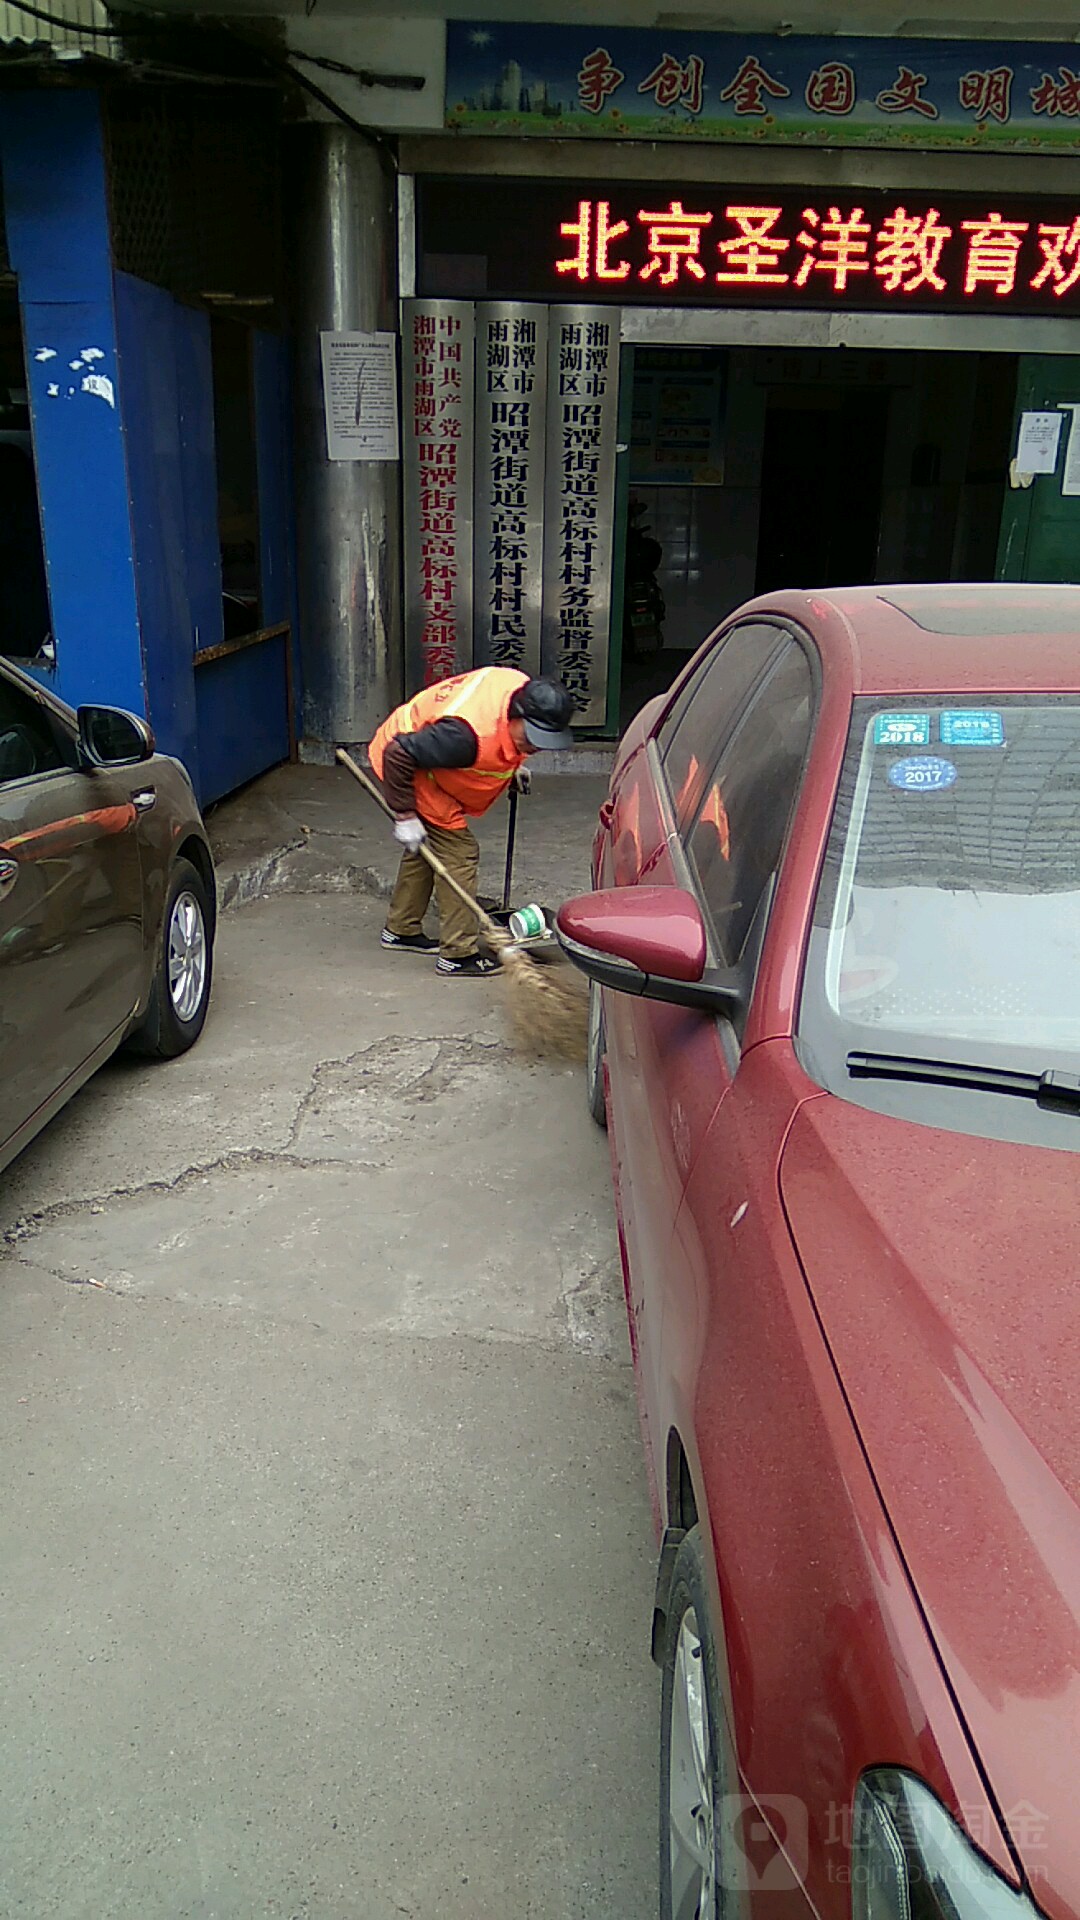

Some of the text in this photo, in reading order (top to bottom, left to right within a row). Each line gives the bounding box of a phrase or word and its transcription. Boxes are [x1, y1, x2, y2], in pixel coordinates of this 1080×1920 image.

[575, 46, 1080, 125] 争创全国文明城
[556, 200, 1080, 295] 北京圣洋教育欢
[414, 315, 436, 438] 湘潭市雨湖区
[439, 315, 462, 438] 中国共产党
[486, 318, 510, 394] 雨湖区
[512, 318, 537, 395] 湘潭市
[559, 322, 583, 397] 雨湖区
[584, 321, 610, 398] 湘潭市
[880, 731, 925, 743] 2018
[905, 771, 942, 783] 2017
